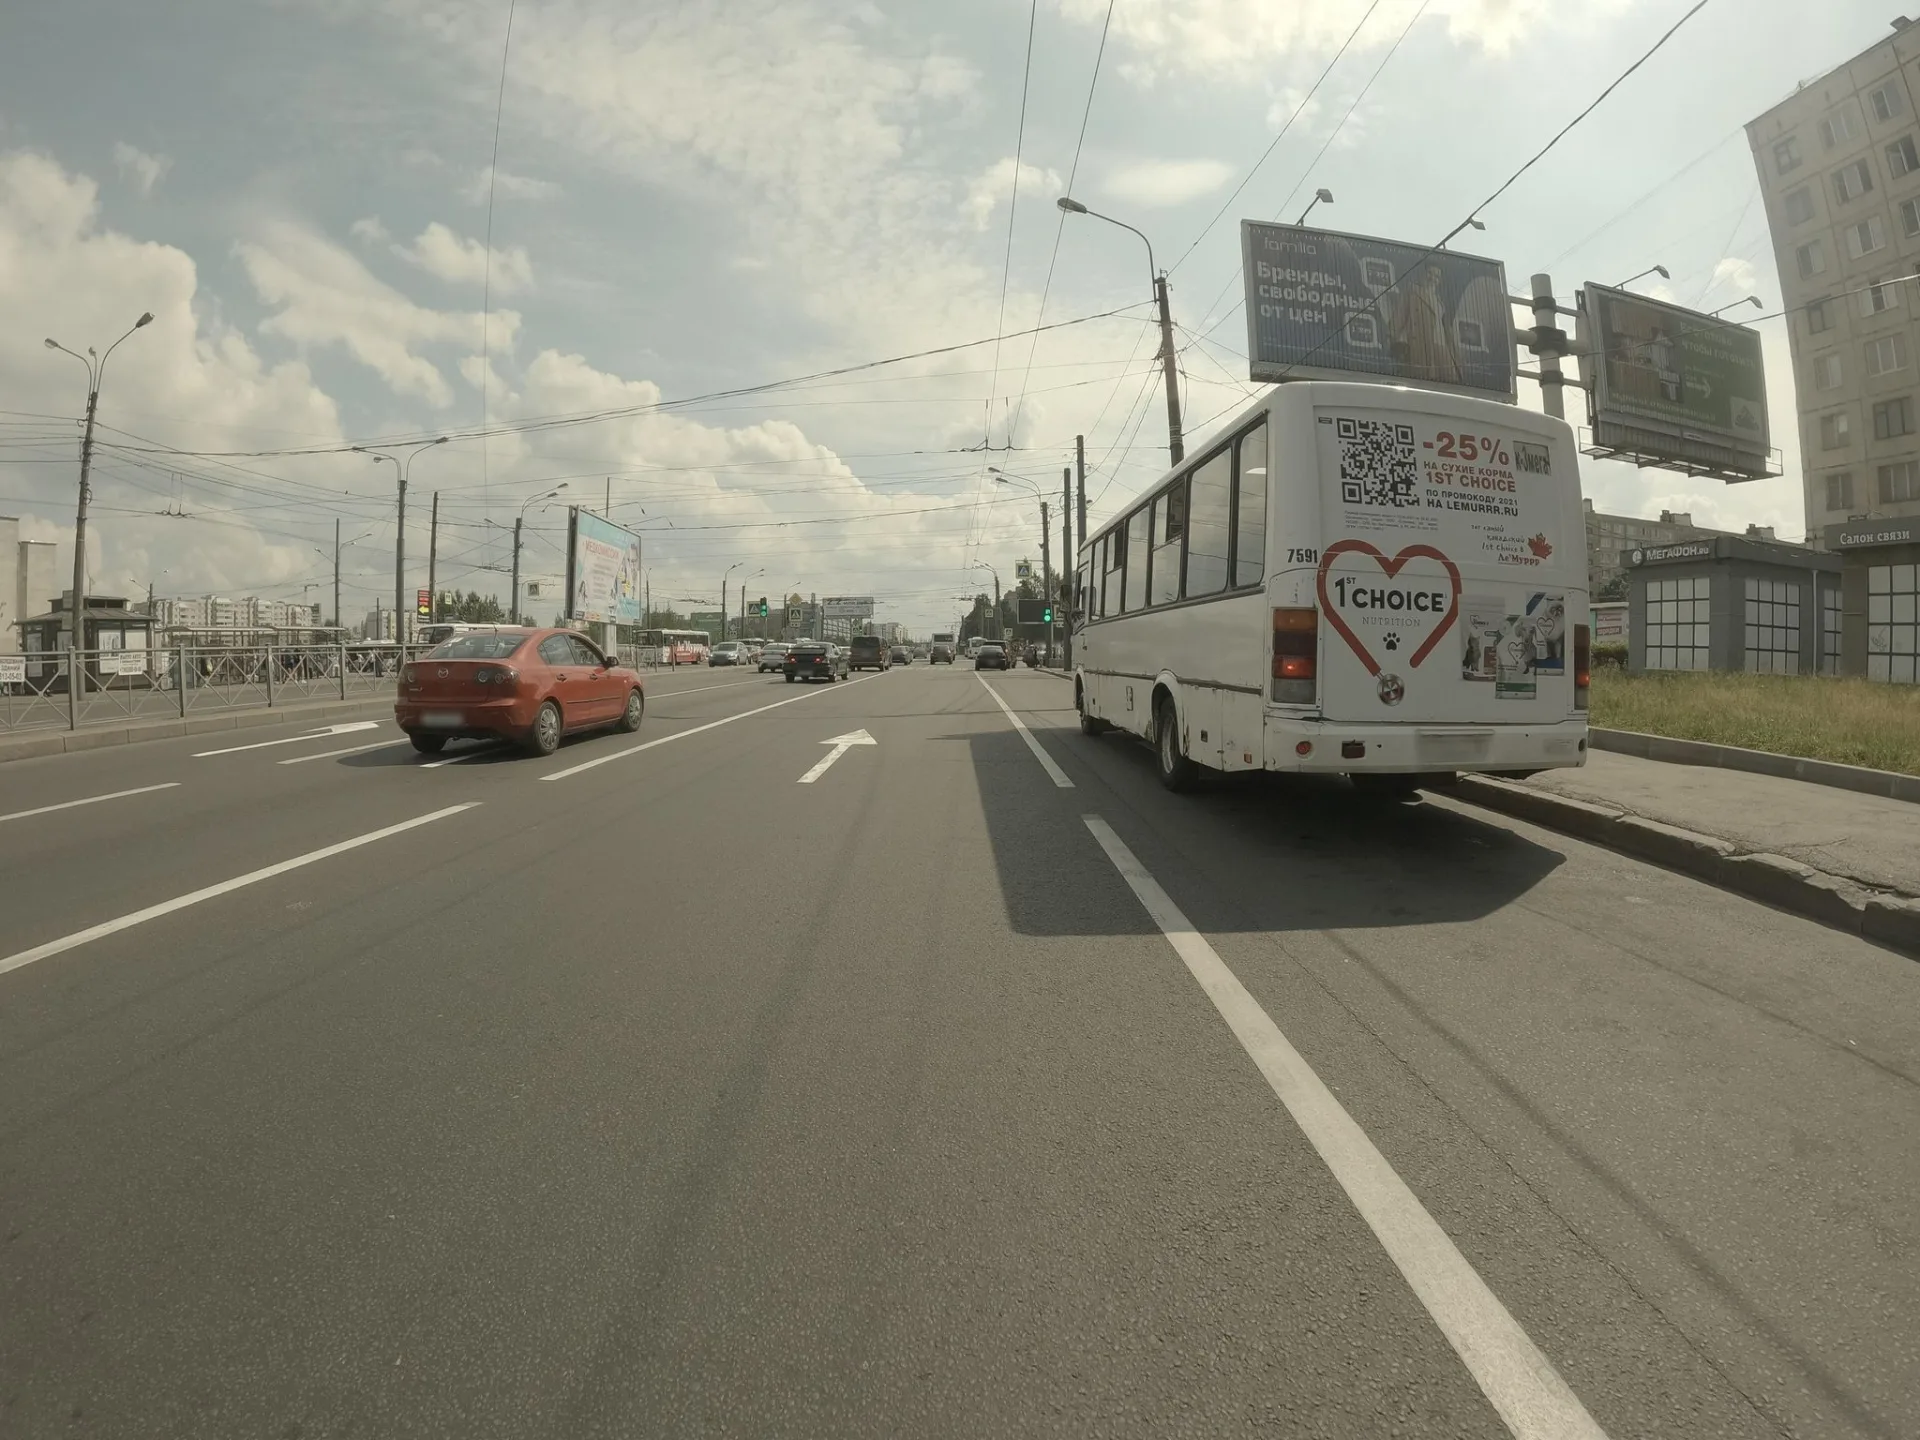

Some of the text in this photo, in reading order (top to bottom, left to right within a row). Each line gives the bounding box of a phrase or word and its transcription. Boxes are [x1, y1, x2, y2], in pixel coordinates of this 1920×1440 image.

[1256, 260, 1347, 291] Бренды,
[1258, 283, 1376, 311] свободные
[1260, 303, 1327, 325] от цен
[1423, 431, 1509, 465] -25%
[1424, 461, 1514, 480] НА СУХИЕ КОРМА
[1426, 471, 1517, 493] 1ST CHOICE
[1426, 489, 1518, 506] ПО ПРОМОКОДУ 2021
[1427, 498, 1519, 517] НА LEMURRR.RU
[1839, 530, 1910, 545] Салон связи
[1287, 549, 1318, 564] 7591
[1351, 588, 1445, 613] CHOICE
[1362, 616, 1421, 627] NUTRITION
